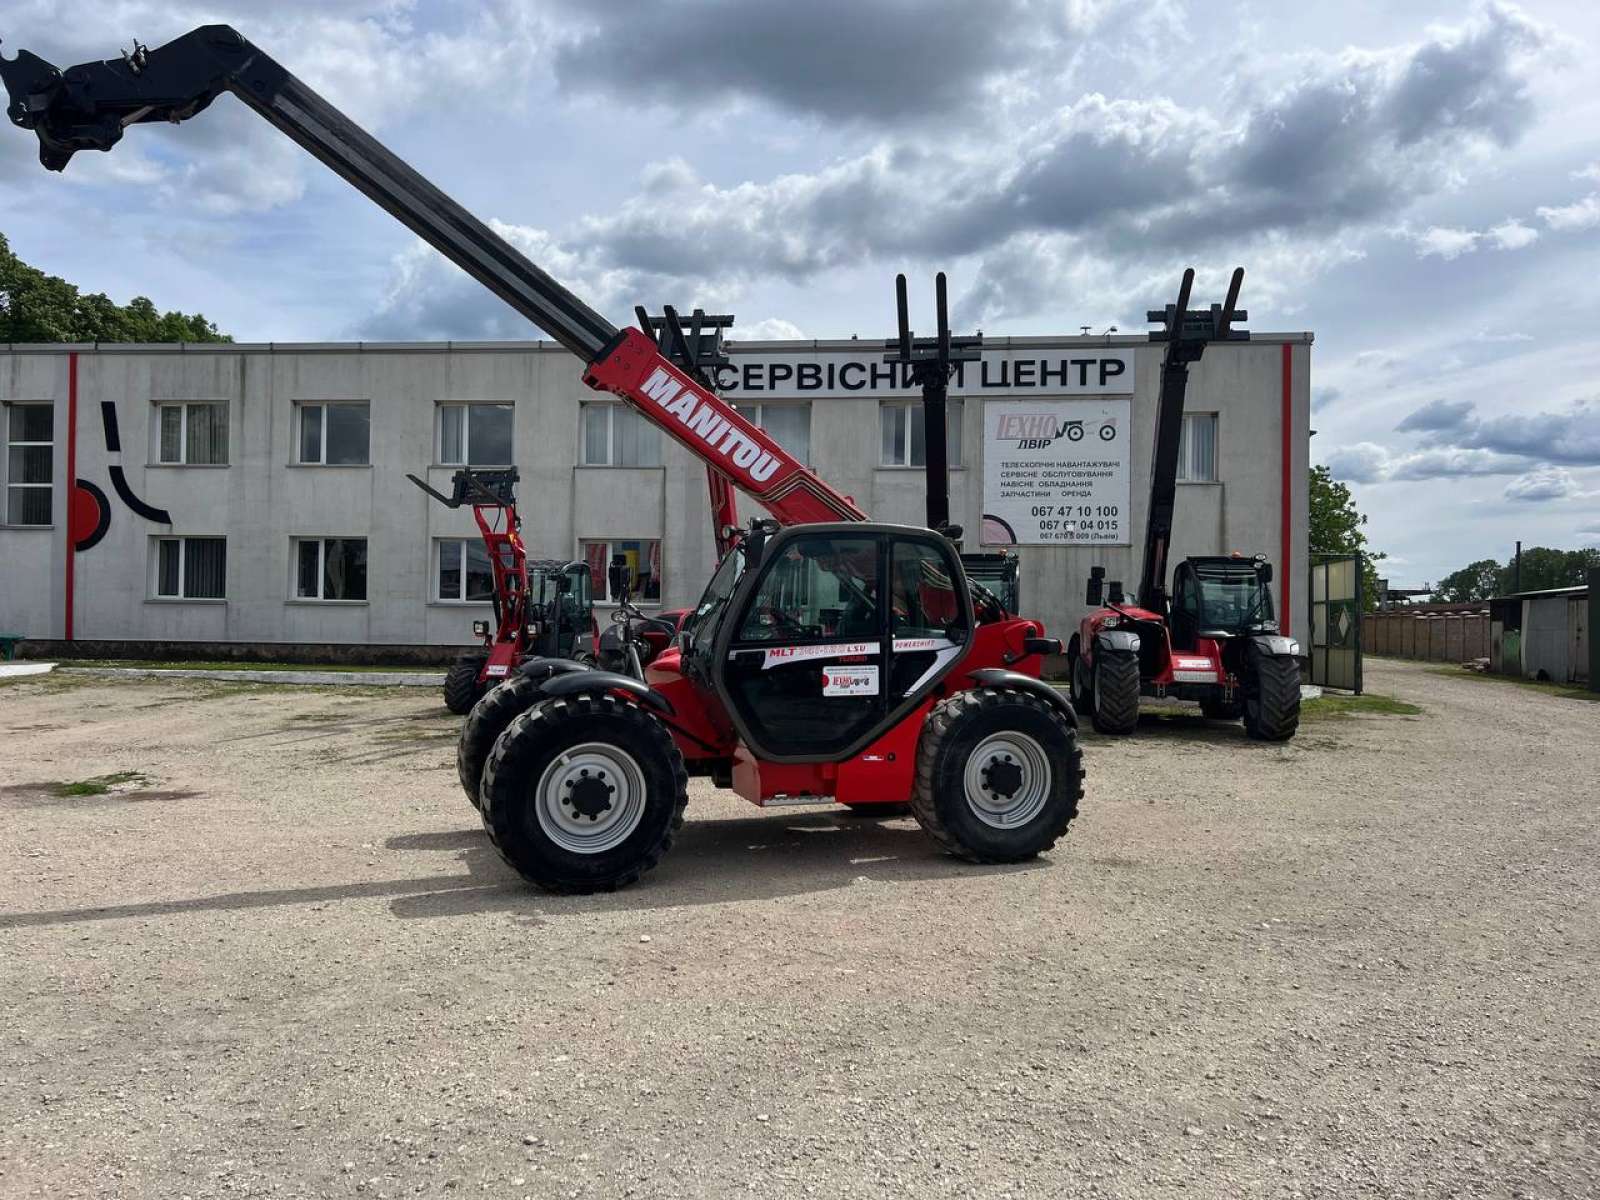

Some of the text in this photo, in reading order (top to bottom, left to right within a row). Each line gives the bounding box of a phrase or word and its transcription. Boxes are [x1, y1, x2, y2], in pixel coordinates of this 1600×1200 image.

[981, 358, 1126, 389] ЦЕНТР
[639, 367, 783, 483] MANITOU
[1031, 506, 1118, 517] 067 47 10 100
[1039, 520, 1060, 530] 067
[1080, 520, 1094, 530] 04
[1097, 520, 1118, 530] 015
[769, 647, 796, 658] MLT
[846, 645, 867, 653] LSU
